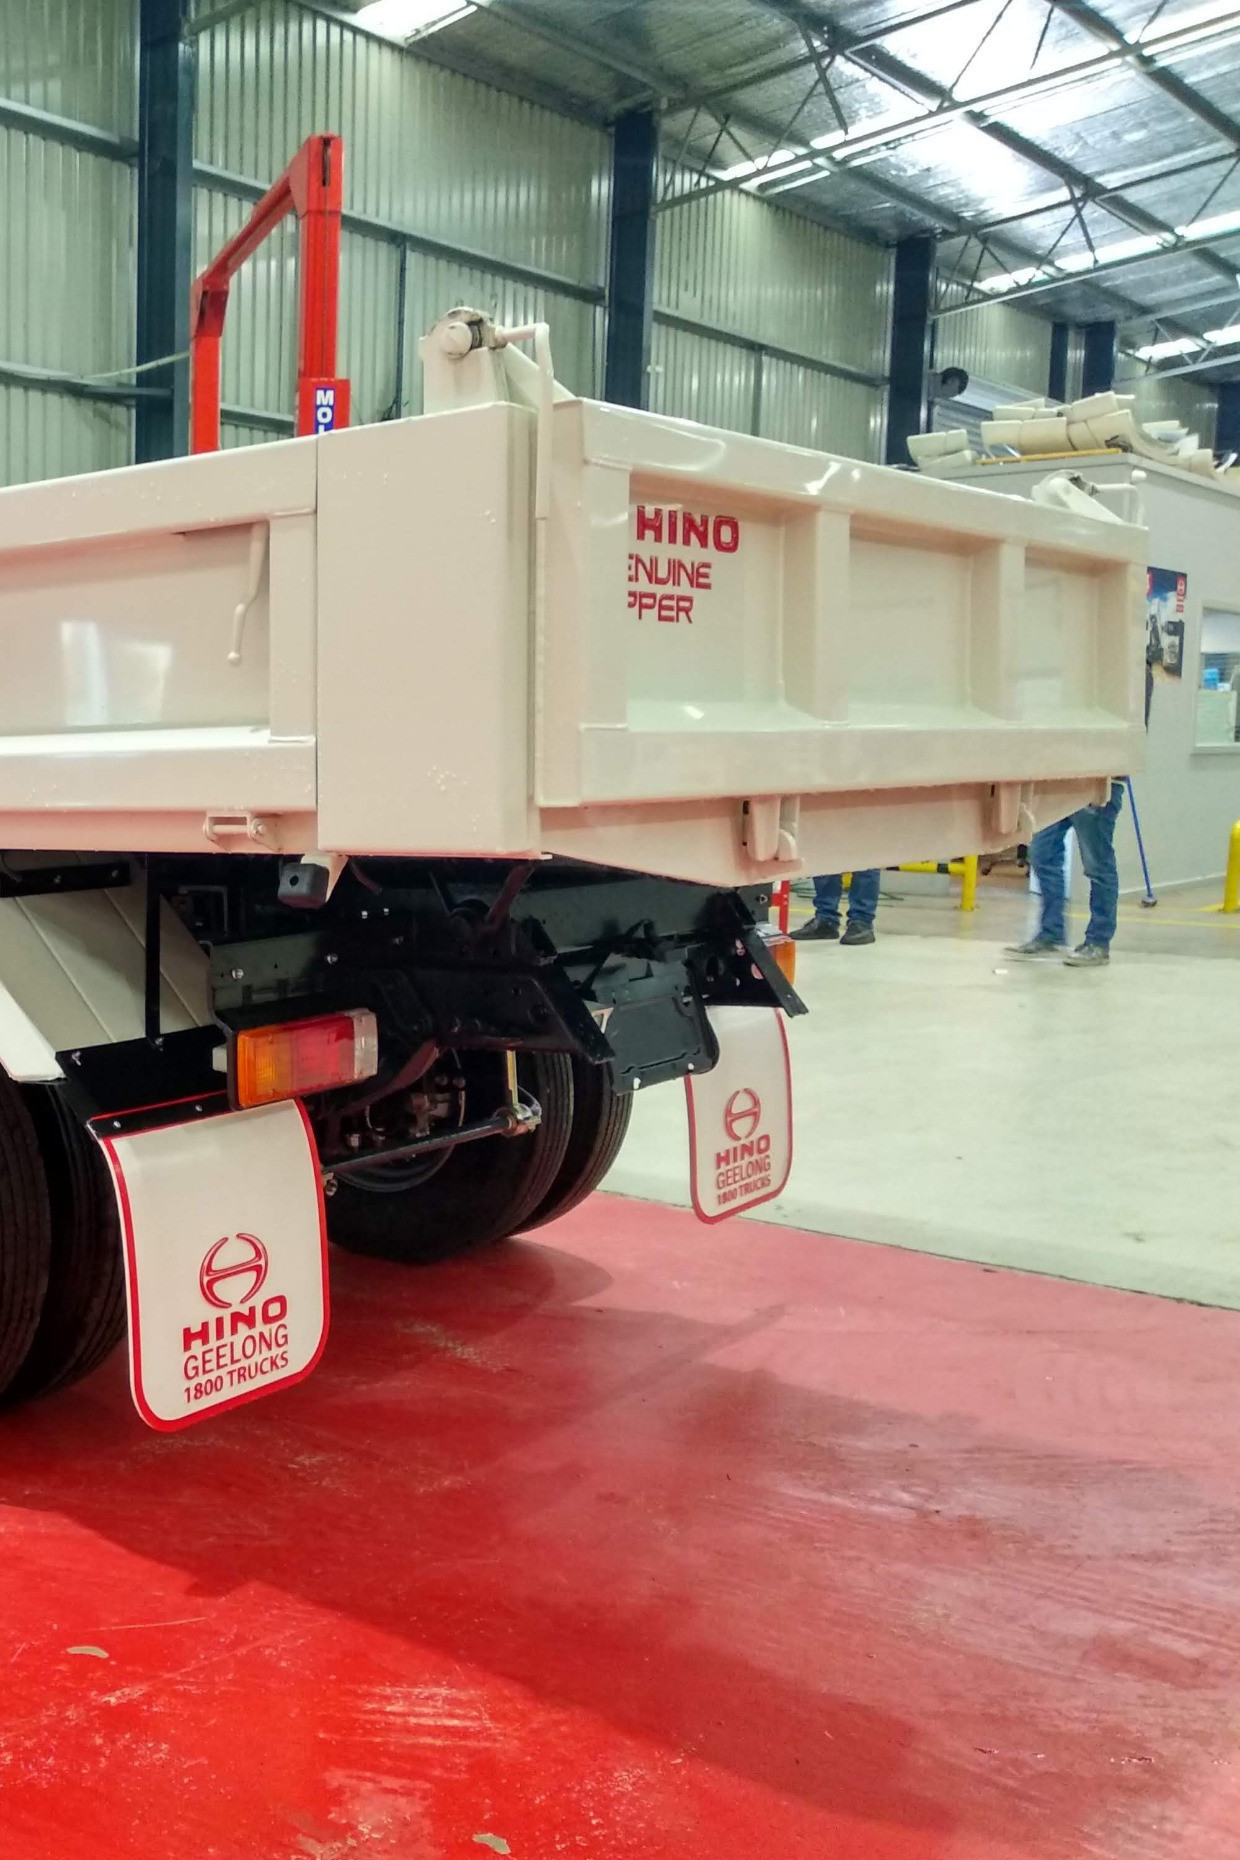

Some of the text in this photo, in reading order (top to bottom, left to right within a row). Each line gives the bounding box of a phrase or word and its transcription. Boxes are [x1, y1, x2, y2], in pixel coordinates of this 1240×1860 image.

[636, 505, 740, 554] HINO
[715, 1133, 771, 1170] HINO
[716, 1155, 772, 1191] GEELONG
[716, 1175, 772, 1206] 1800 TRUCKS
[182, 1295, 288, 1353] HINO
[183, 1323, 289, 1381] GEELONG
[184, 1350, 289, 1404] 1800 TRUCKS
